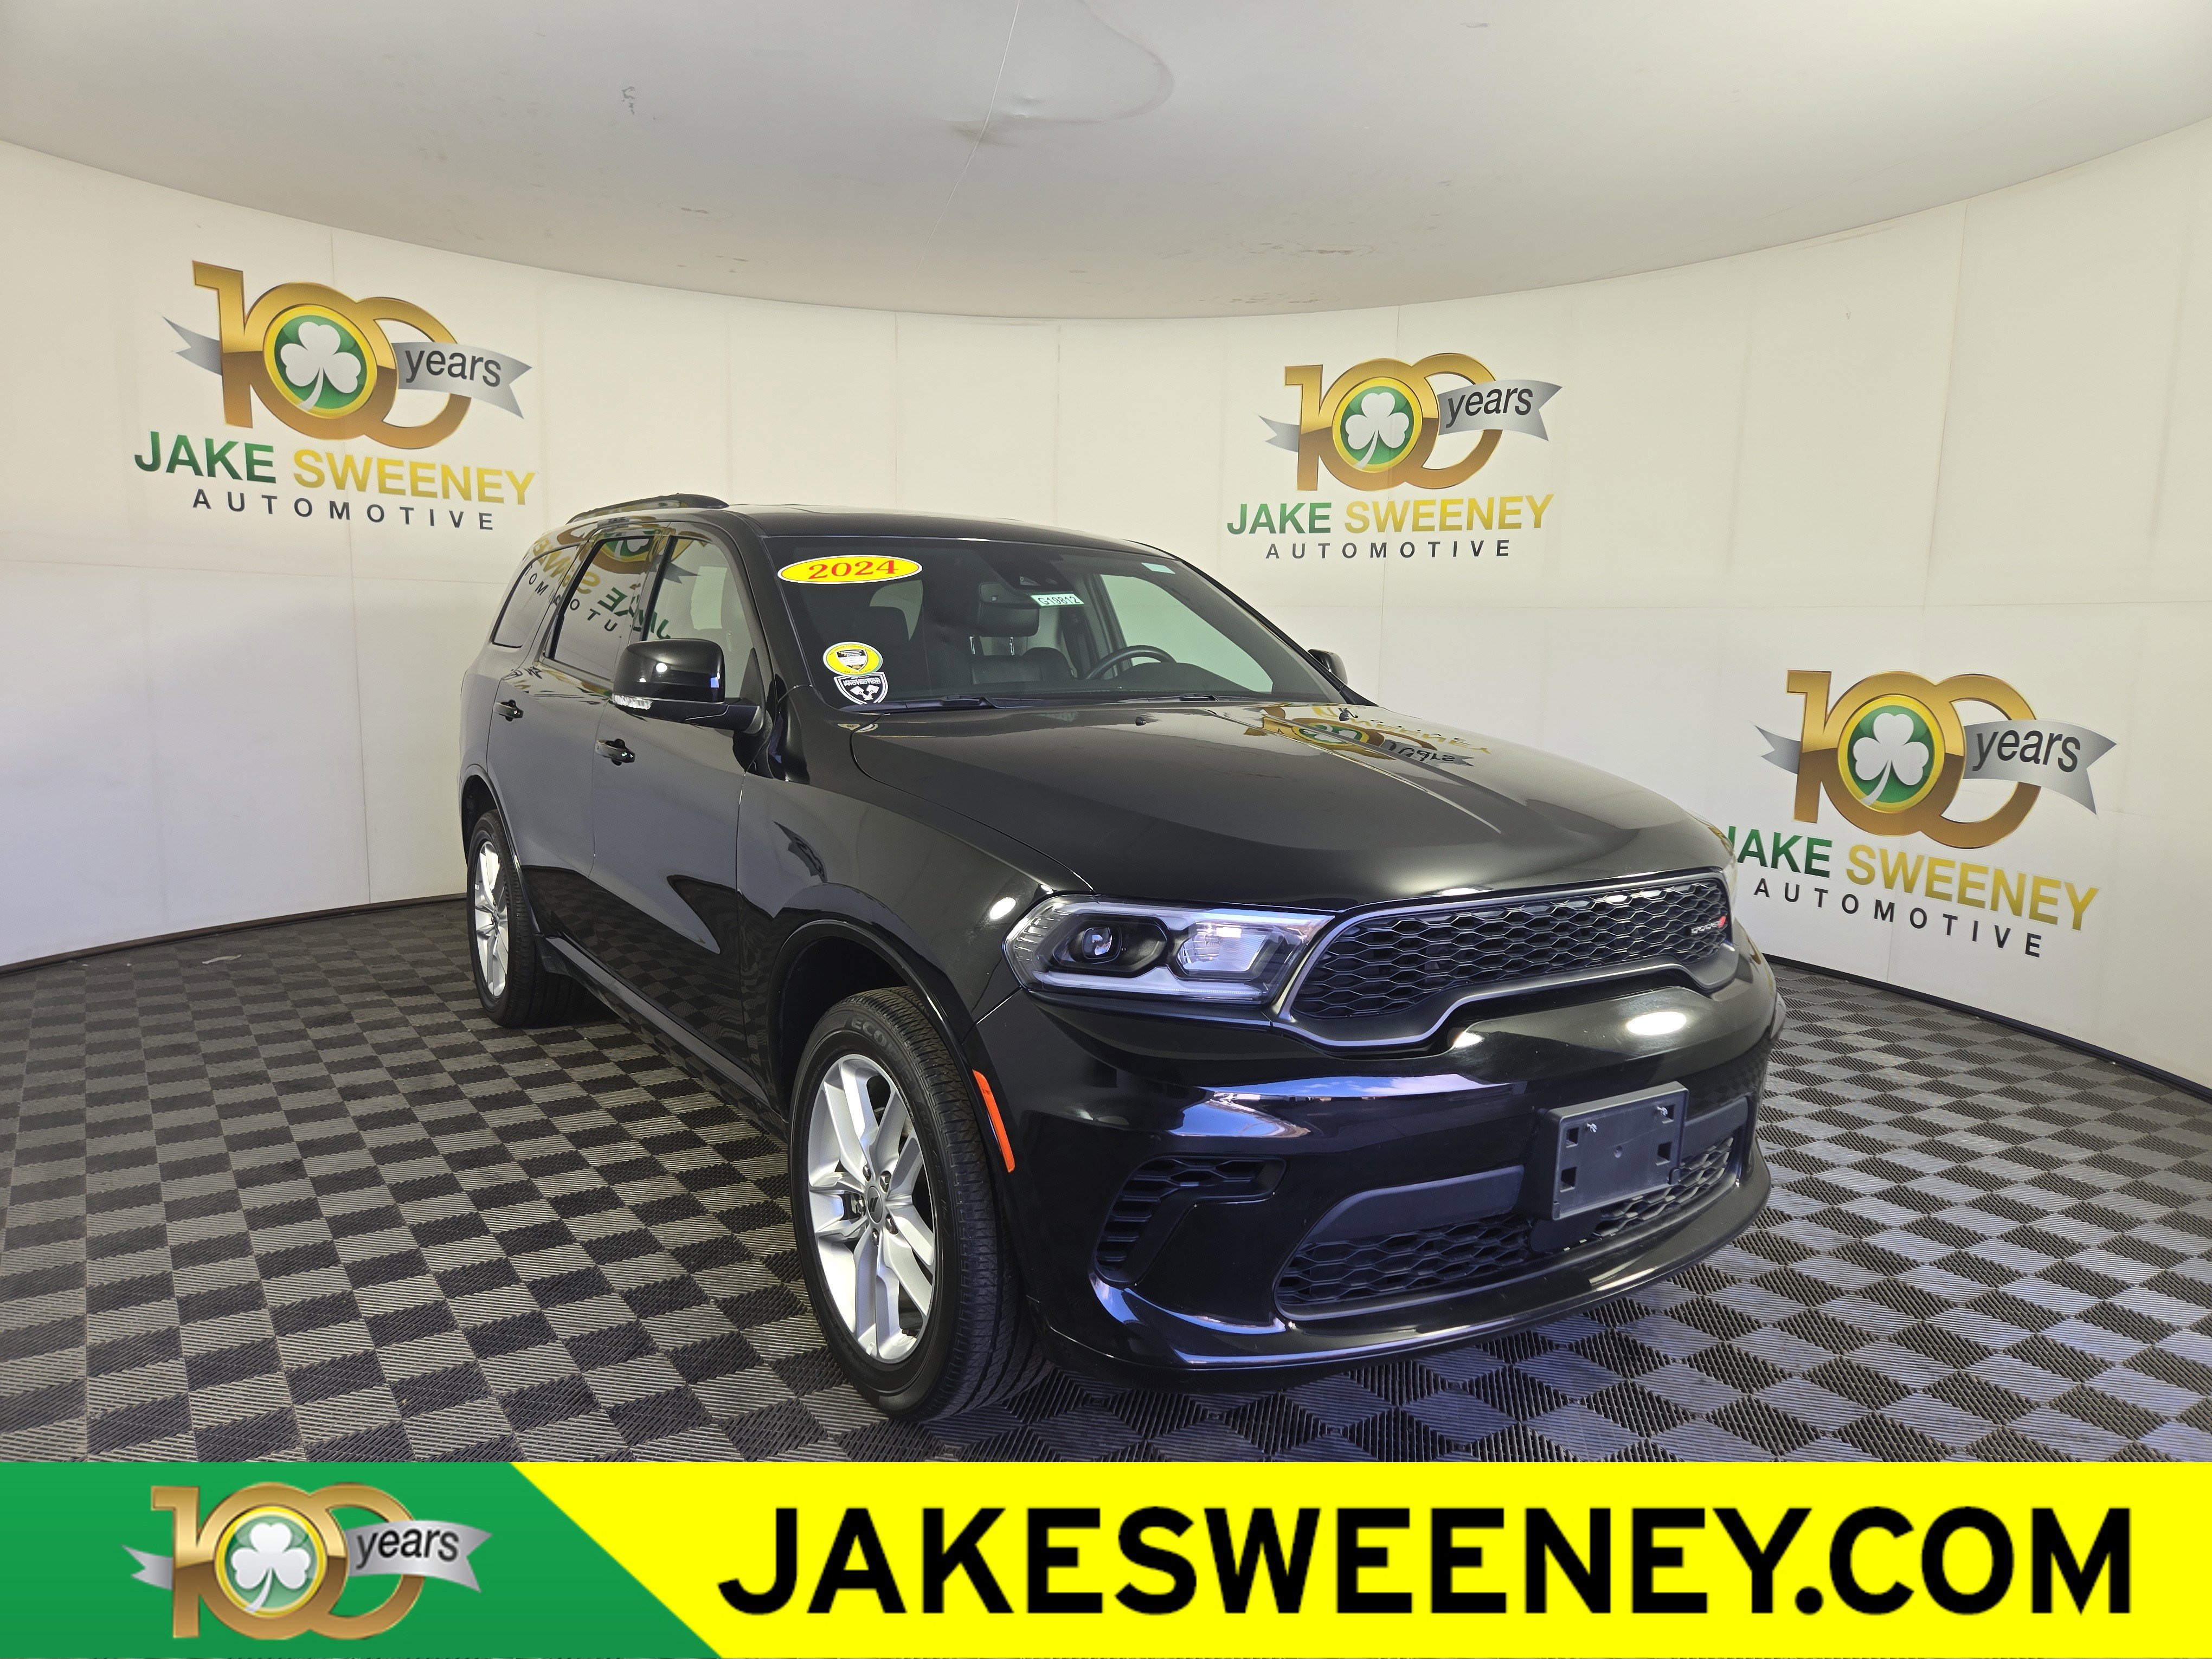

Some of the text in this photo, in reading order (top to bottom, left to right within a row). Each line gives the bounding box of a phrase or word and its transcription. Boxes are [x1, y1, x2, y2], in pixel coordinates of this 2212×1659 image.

[404, 350, 502, 388] years
[1445, 386, 1534, 429] years
[134, 430, 535, 505] JAKE SWEENEY
[192, 488, 494, 530] AUTOMOTIVE
[1227, 494, 1554, 535] JAKE SWEENEY
[808, 560, 899, 580] 2024
[1265, 539, 1509, 559] AUTOMOTIVE
[1038, 596, 1080, 605] G19812
[1971, 730, 2081, 773] years
[1846, 844, 2100, 931] SWEENEY
[1753, 878, 2042, 958] AUTOMOTIVE
